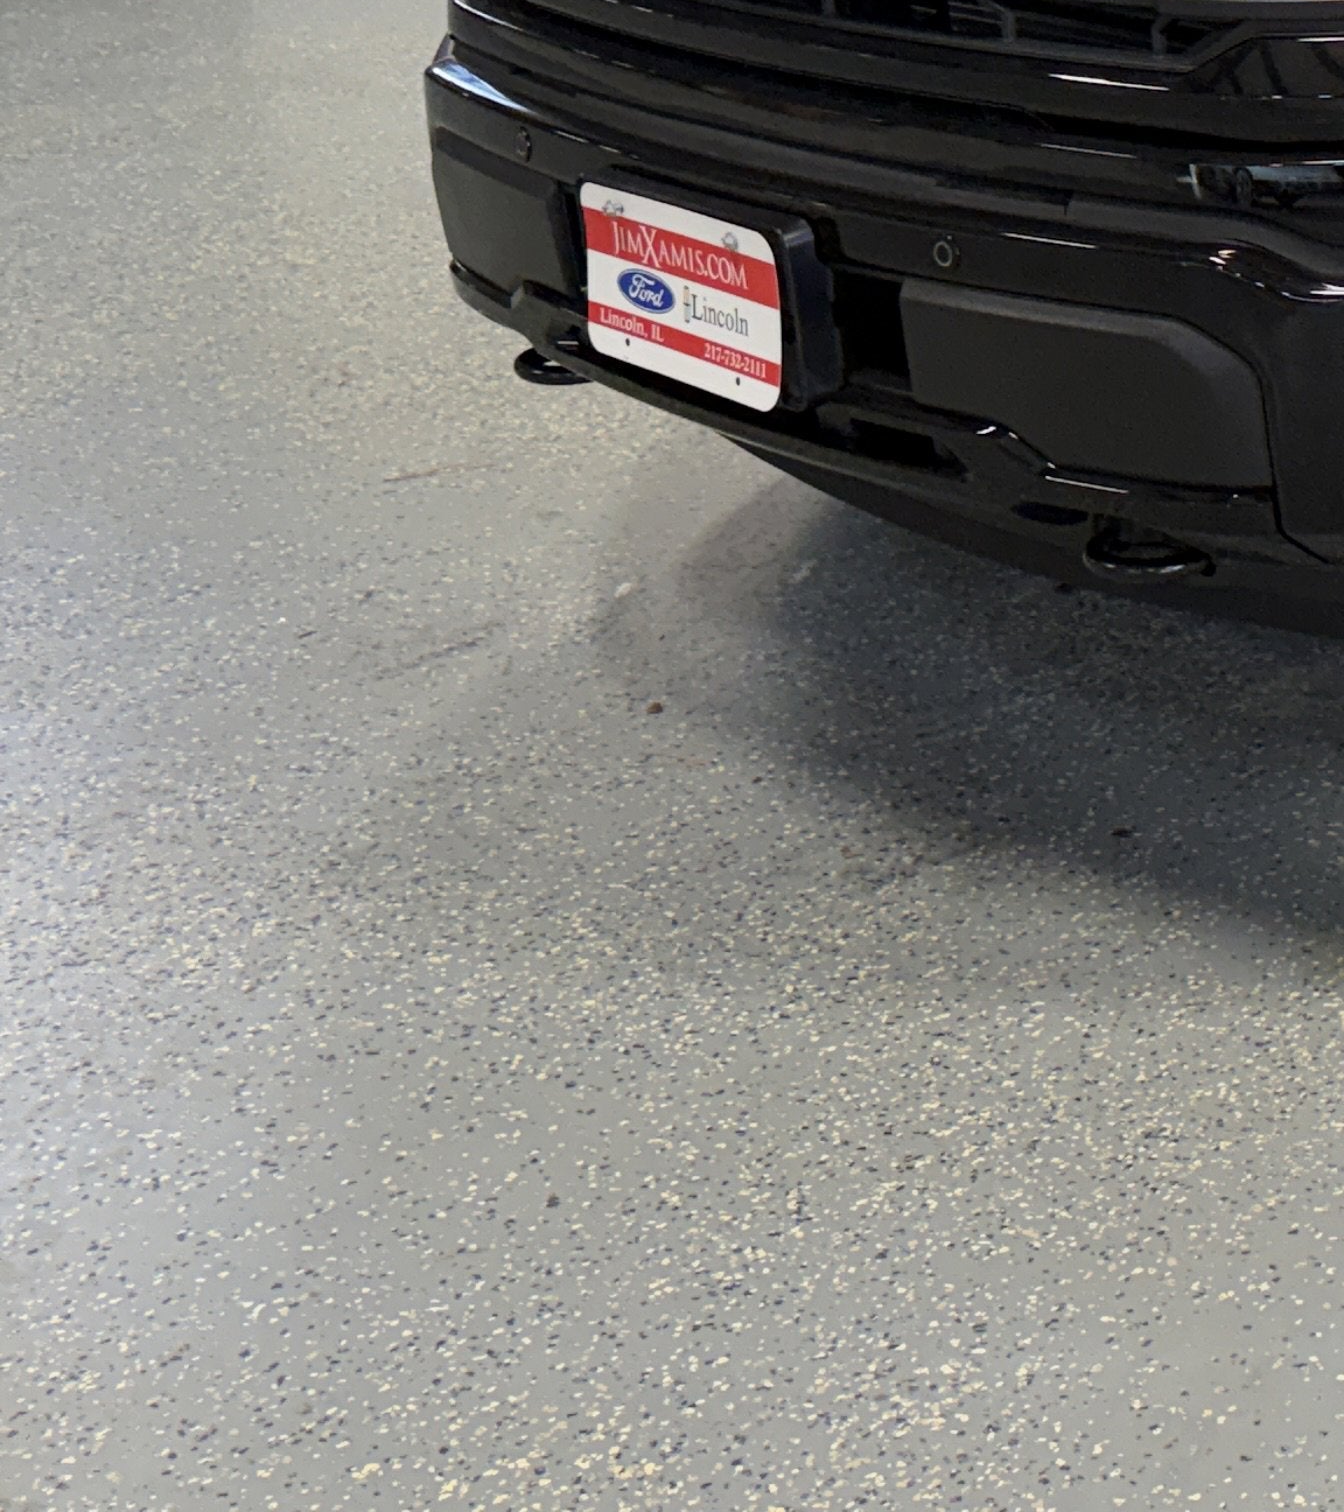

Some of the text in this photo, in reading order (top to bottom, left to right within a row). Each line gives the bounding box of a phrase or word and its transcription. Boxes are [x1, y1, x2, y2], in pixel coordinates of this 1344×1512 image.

[611, 220, 749, 290] JIMXAMIS.COM
[628, 274, 749, 337] Ford Lincoln
[599, 307, 767, 379] Lincoln, IL 217-732-2111
